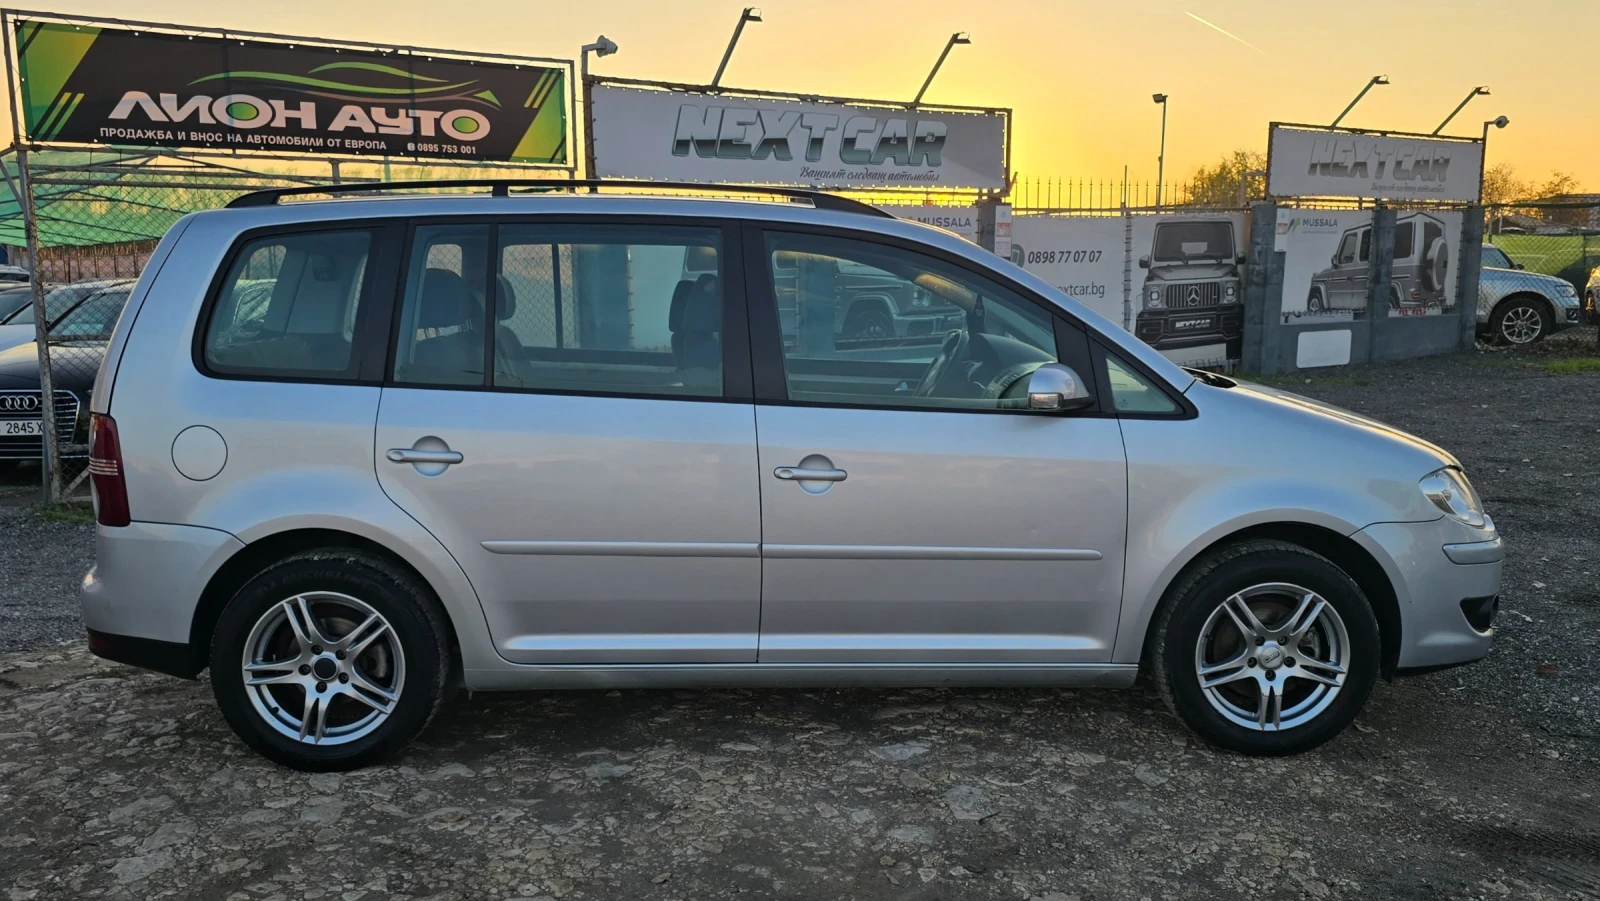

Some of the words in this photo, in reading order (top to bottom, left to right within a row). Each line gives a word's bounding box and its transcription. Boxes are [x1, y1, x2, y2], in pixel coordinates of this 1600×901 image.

[108, 90, 317, 130] ЛИОН
[327, 104, 491, 141] АУТО
[100, 127, 174, 140] ПРОДАЖБА
[178, 131, 186, 141] И
[190, 131, 223, 143] ВНОС
[227, 133, 243, 143] НА
[246, 135, 324, 147] АВТОМОБИЛИ
[327, 138, 342, 148] ОТ
[345, 139, 387, 151] ЕВРОПА
[417, 143, 439, 153] 0895
[441, 144, 458, 154] 753
[460, 145, 476, 155] 001
[1302, 218, 1338, 227] MUSSALA
[1027, 250, 1056, 264] 0898
[1057, 250, 1072, 264] 77
[1073, 250, 1088, 263] 07
[1088, 250, 1103, 263] 07
[6, 422, 34, 434] 2845
